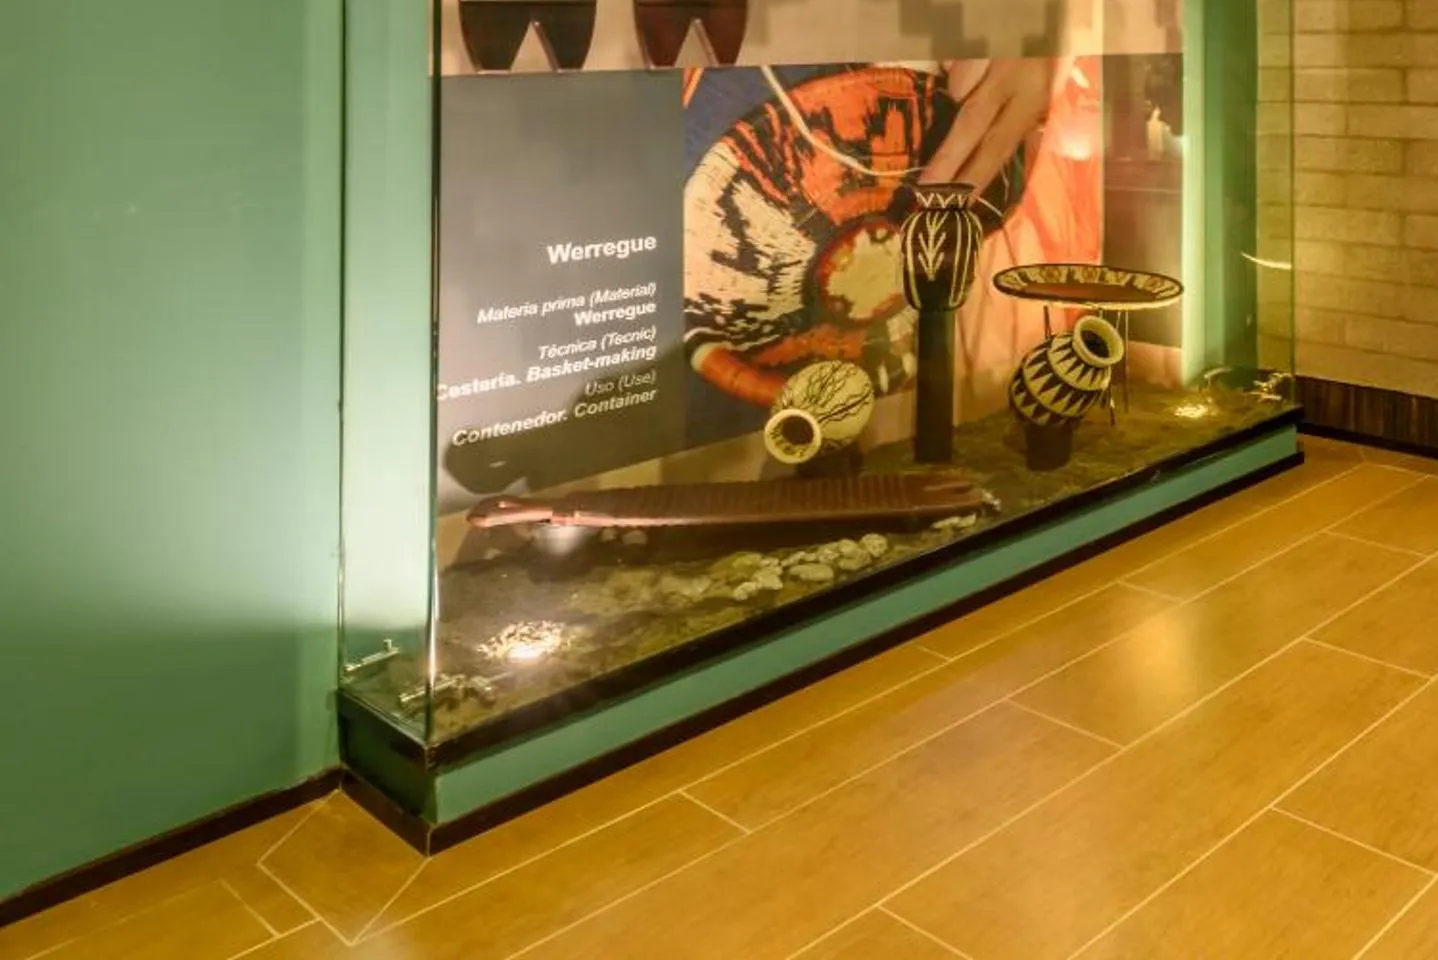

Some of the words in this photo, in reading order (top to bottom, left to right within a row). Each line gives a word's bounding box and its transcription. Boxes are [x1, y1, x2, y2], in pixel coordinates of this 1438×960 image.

[547, 236, 657, 264] Werregue
[476, 302, 538, 324] Materia
[541, 295, 585, 317] prima
[589, 282, 657, 307] (Material)
[573, 302, 657, 326] Werregue
[526, 345, 657, 382] Basket-making
[538, 339, 597, 360] Técnica
[585, 381, 615, 397] Uso
[618, 369, 657, 392] (Use)
[452, 408, 568, 447] Contenedor.
[574, 389, 657, 418] Container
